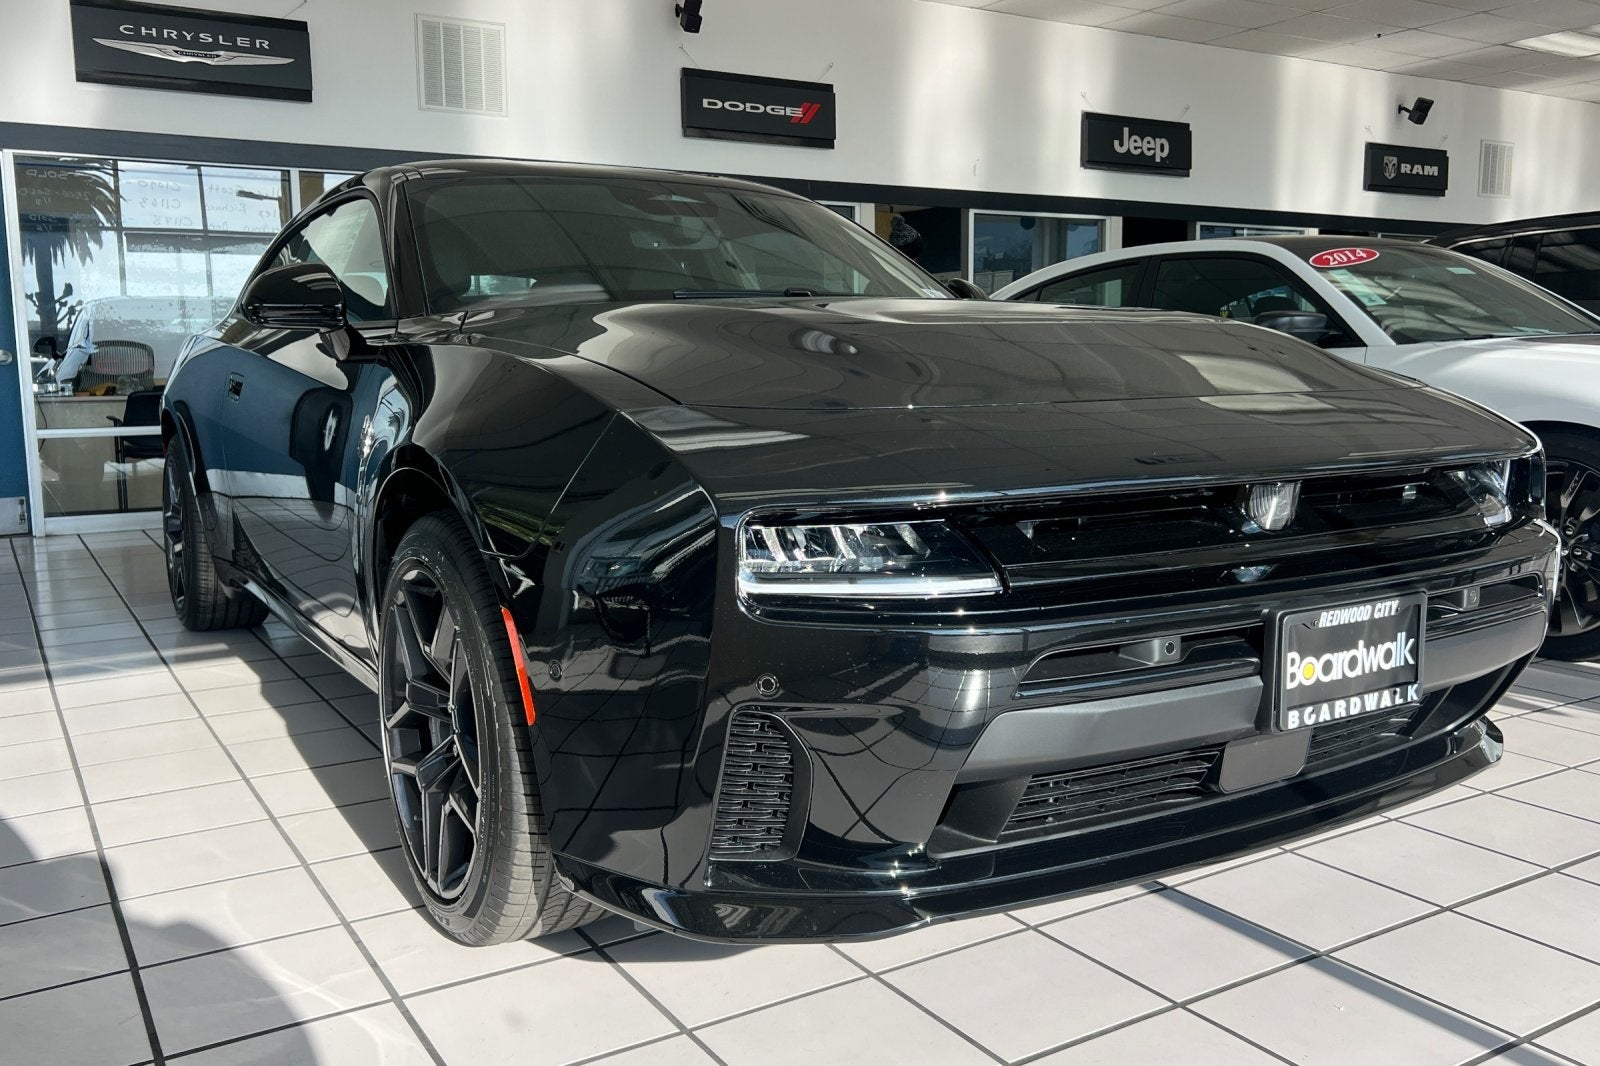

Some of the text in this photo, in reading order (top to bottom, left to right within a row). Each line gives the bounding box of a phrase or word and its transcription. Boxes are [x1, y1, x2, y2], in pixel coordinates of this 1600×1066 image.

[118, 24, 270, 50] CHRYSLER
[702, 98, 804, 117] DODGE
[1113, 127, 1170, 162] Jeep
[1400, 163, 1439, 176] RAM
[1322, 247, 1367, 266] 2014
[1318, 599, 1401, 628] REDWOOD CITY
[1286, 631, 1416, 690] Boardwalk
[1287, 683, 1419, 730] BOARDWALK
